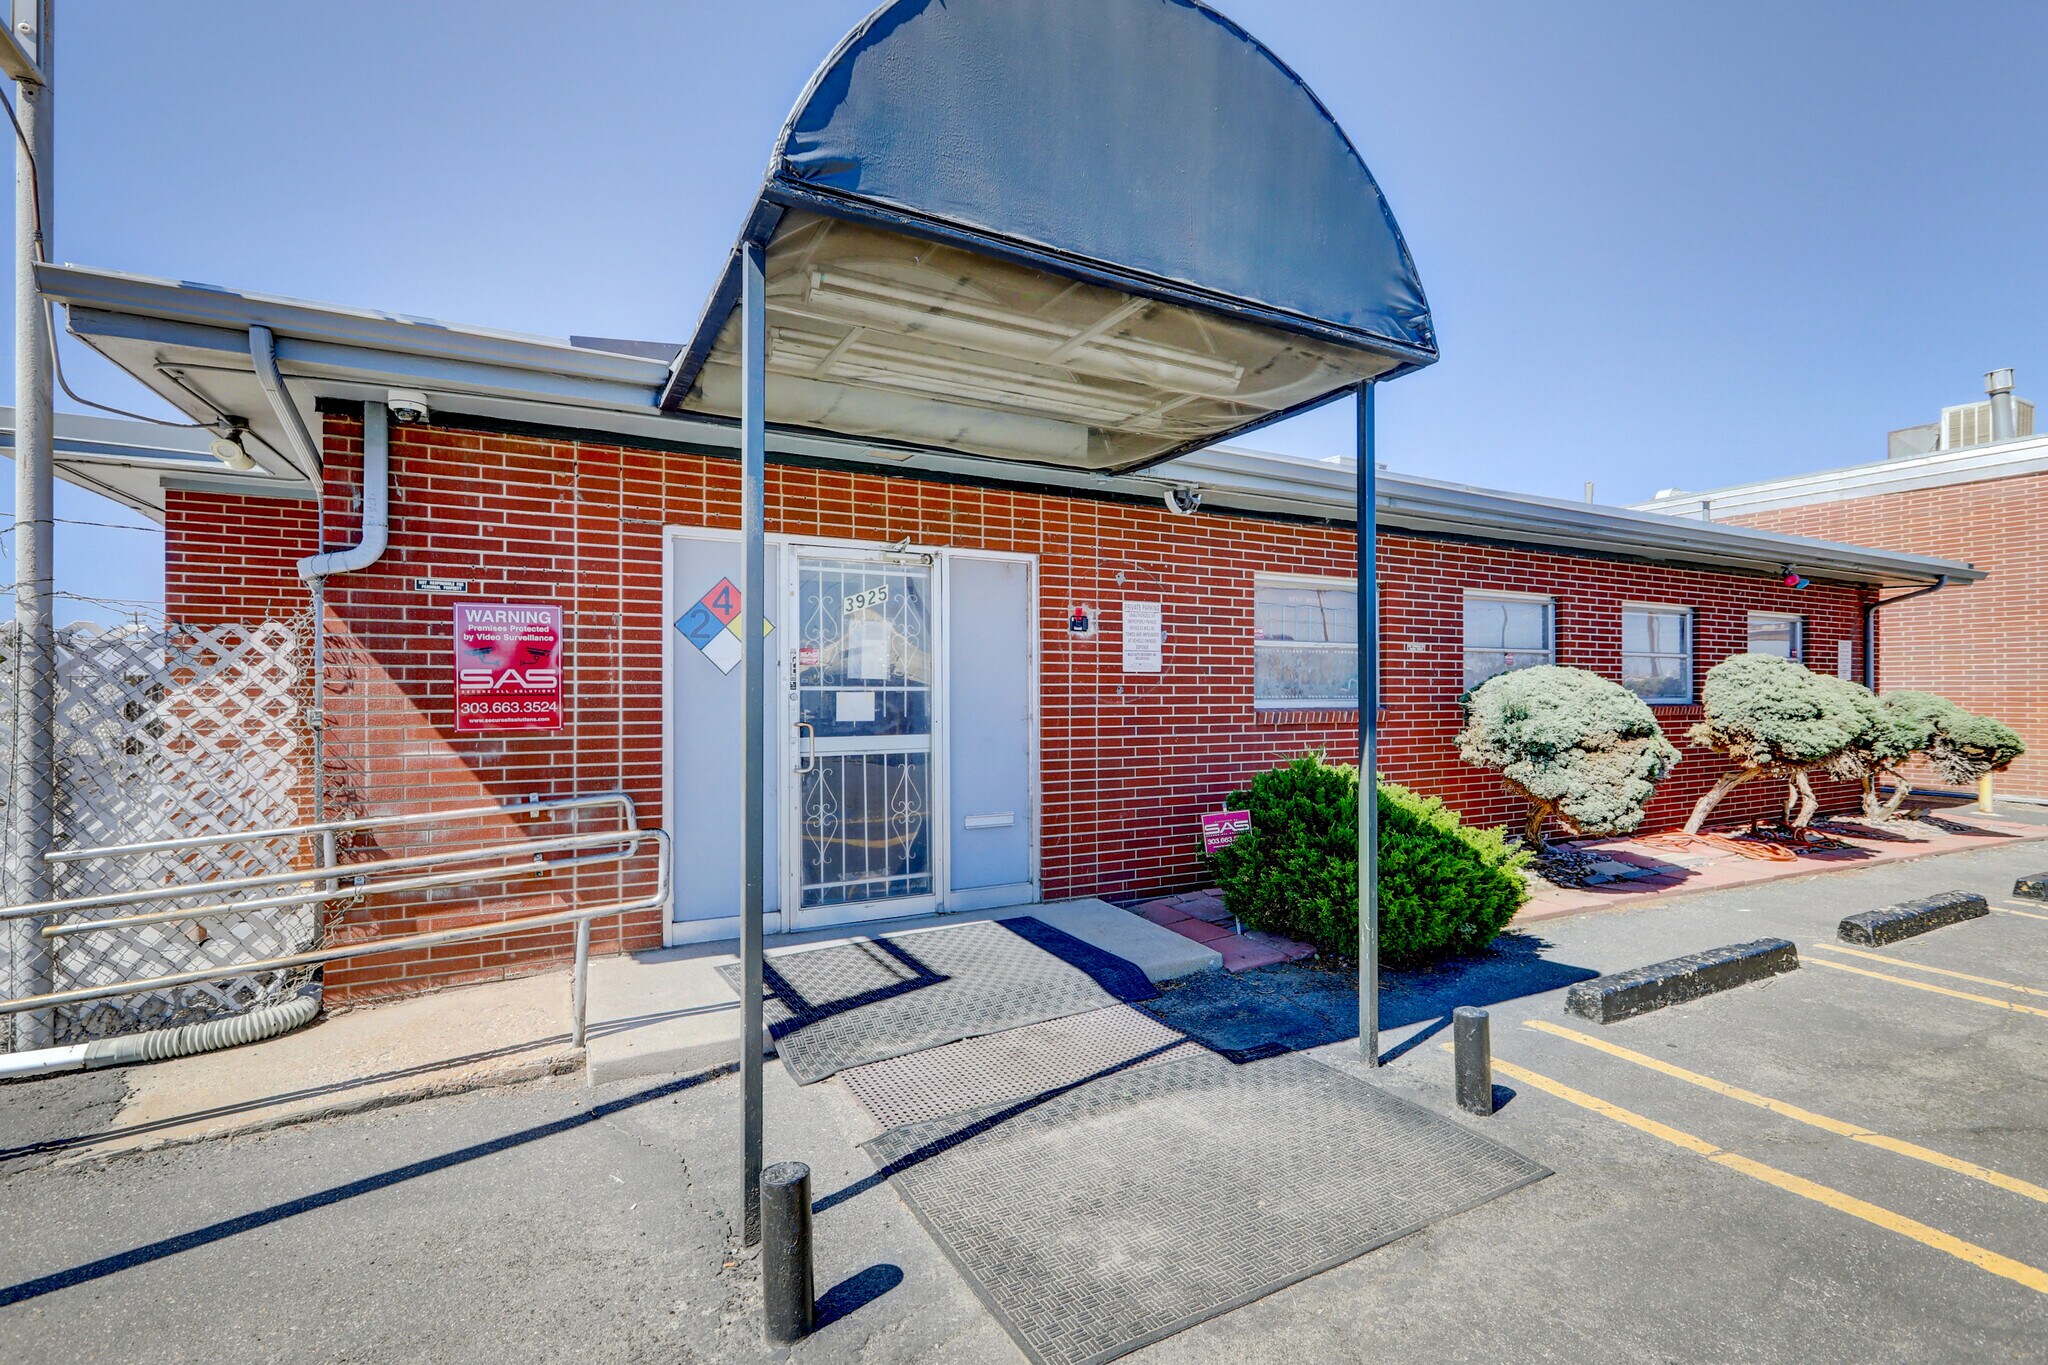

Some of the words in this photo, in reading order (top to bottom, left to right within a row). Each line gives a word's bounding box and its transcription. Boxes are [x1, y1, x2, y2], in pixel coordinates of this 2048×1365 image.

[712, 585, 734, 615] 4
[845, 586, 888, 612] 3925
[1125, 603, 1142, 611] PRIVATE
[465, 609, 551, 624] WARNING
[690, 608, 710, 639] 2
[468, 624, 507, 632] Premises
[509, 625, 550, 633] Protected
[463, 633, 474, 642] by
[476, 633, 501, 641] Video
[503, 634, 554, 642] Surveillance
[460, 668, 558, 689] SAS
[460, 701, 558, 714] 303.663.3524
[1204, 820, 1250, 835] SAS
